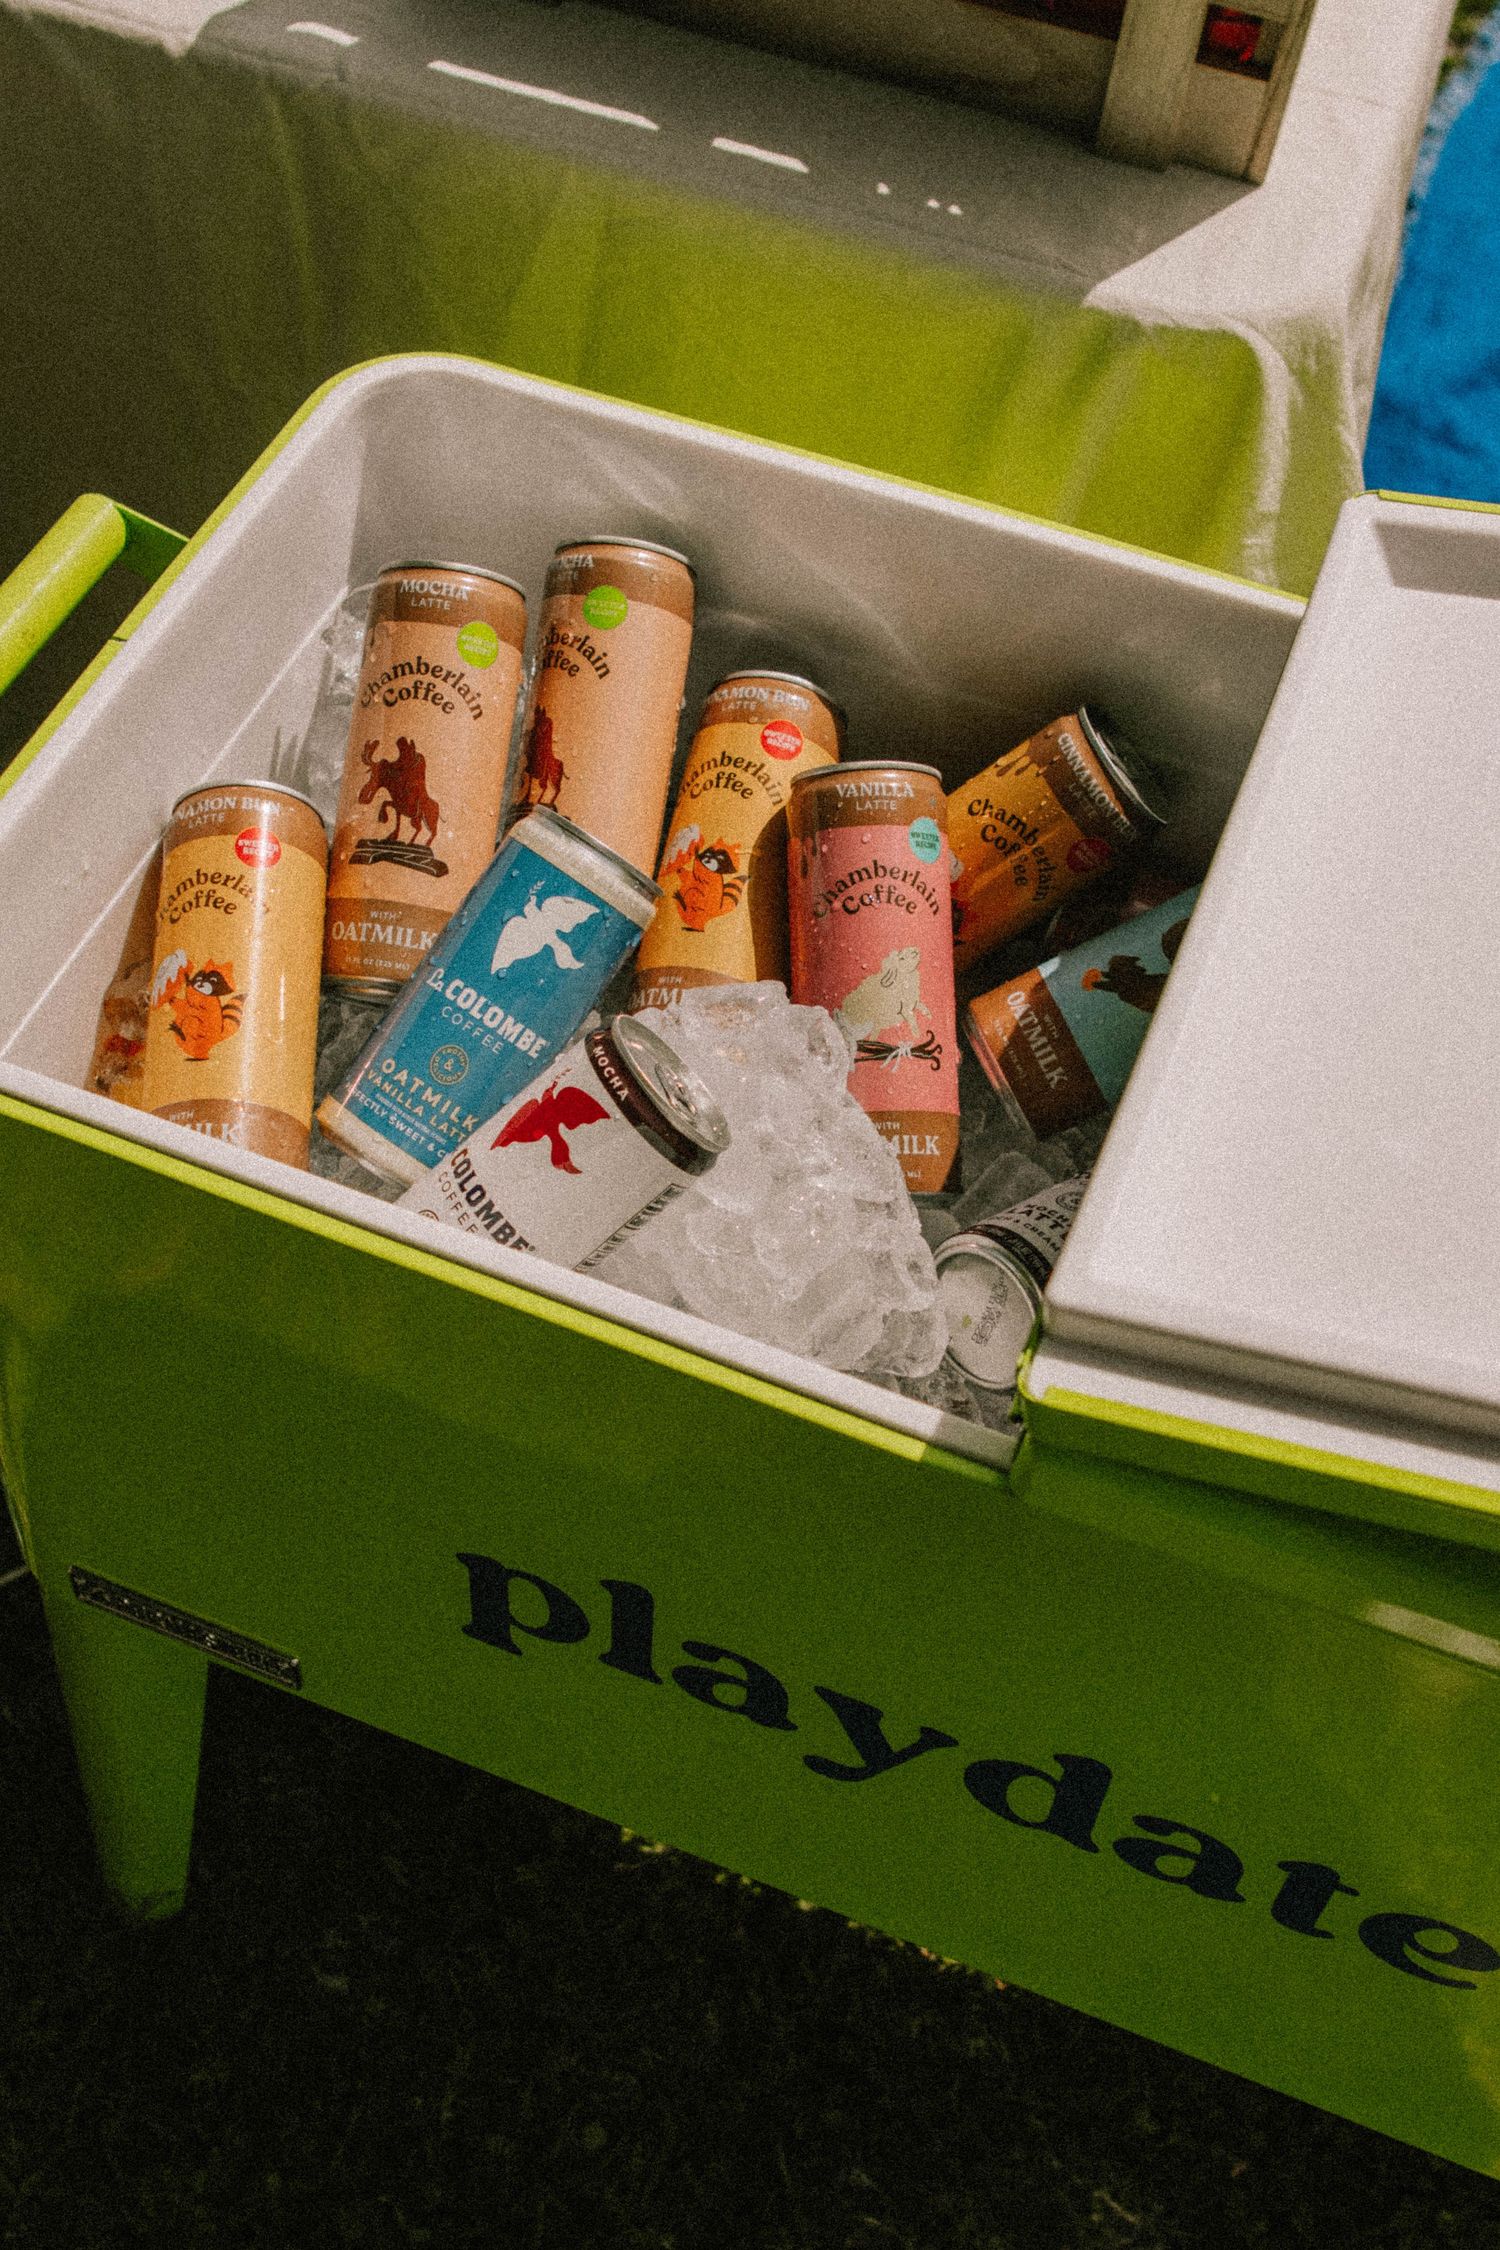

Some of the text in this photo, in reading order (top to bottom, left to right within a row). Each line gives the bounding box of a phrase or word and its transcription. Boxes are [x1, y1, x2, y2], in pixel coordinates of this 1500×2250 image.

[400, 578, 469, 601] MOCHA
[411, 597, 451, 611] LATTE
[360, 655, 484, 721] Chamberlain
[382, 680, 455, 715] Coffee
[690, 771, 754, 800] Coffee
[835, 781, 915, 798] VANILLA
[856, 799, 898, 811] LATTE
[169, 888, 238, 925] Coffee
[813, 859, 940, 919] Chamberlain
[841, 883, 918, 915] Coffee
[331, 921, 439, 951] OATMILK
[441, 1005, 505, 1055] COFFEE
[444, 978, 548, 1060] COLOMBE
[1007, 990, 1068, 1090] OATMILK
[366, 1068, 425, 1119] VANILLA
[381, 1056, 482, 1133] OATMILK
[592, 1045, 630, 1101] MOCHA
[455, 1552, 1500, 1991] playdate
